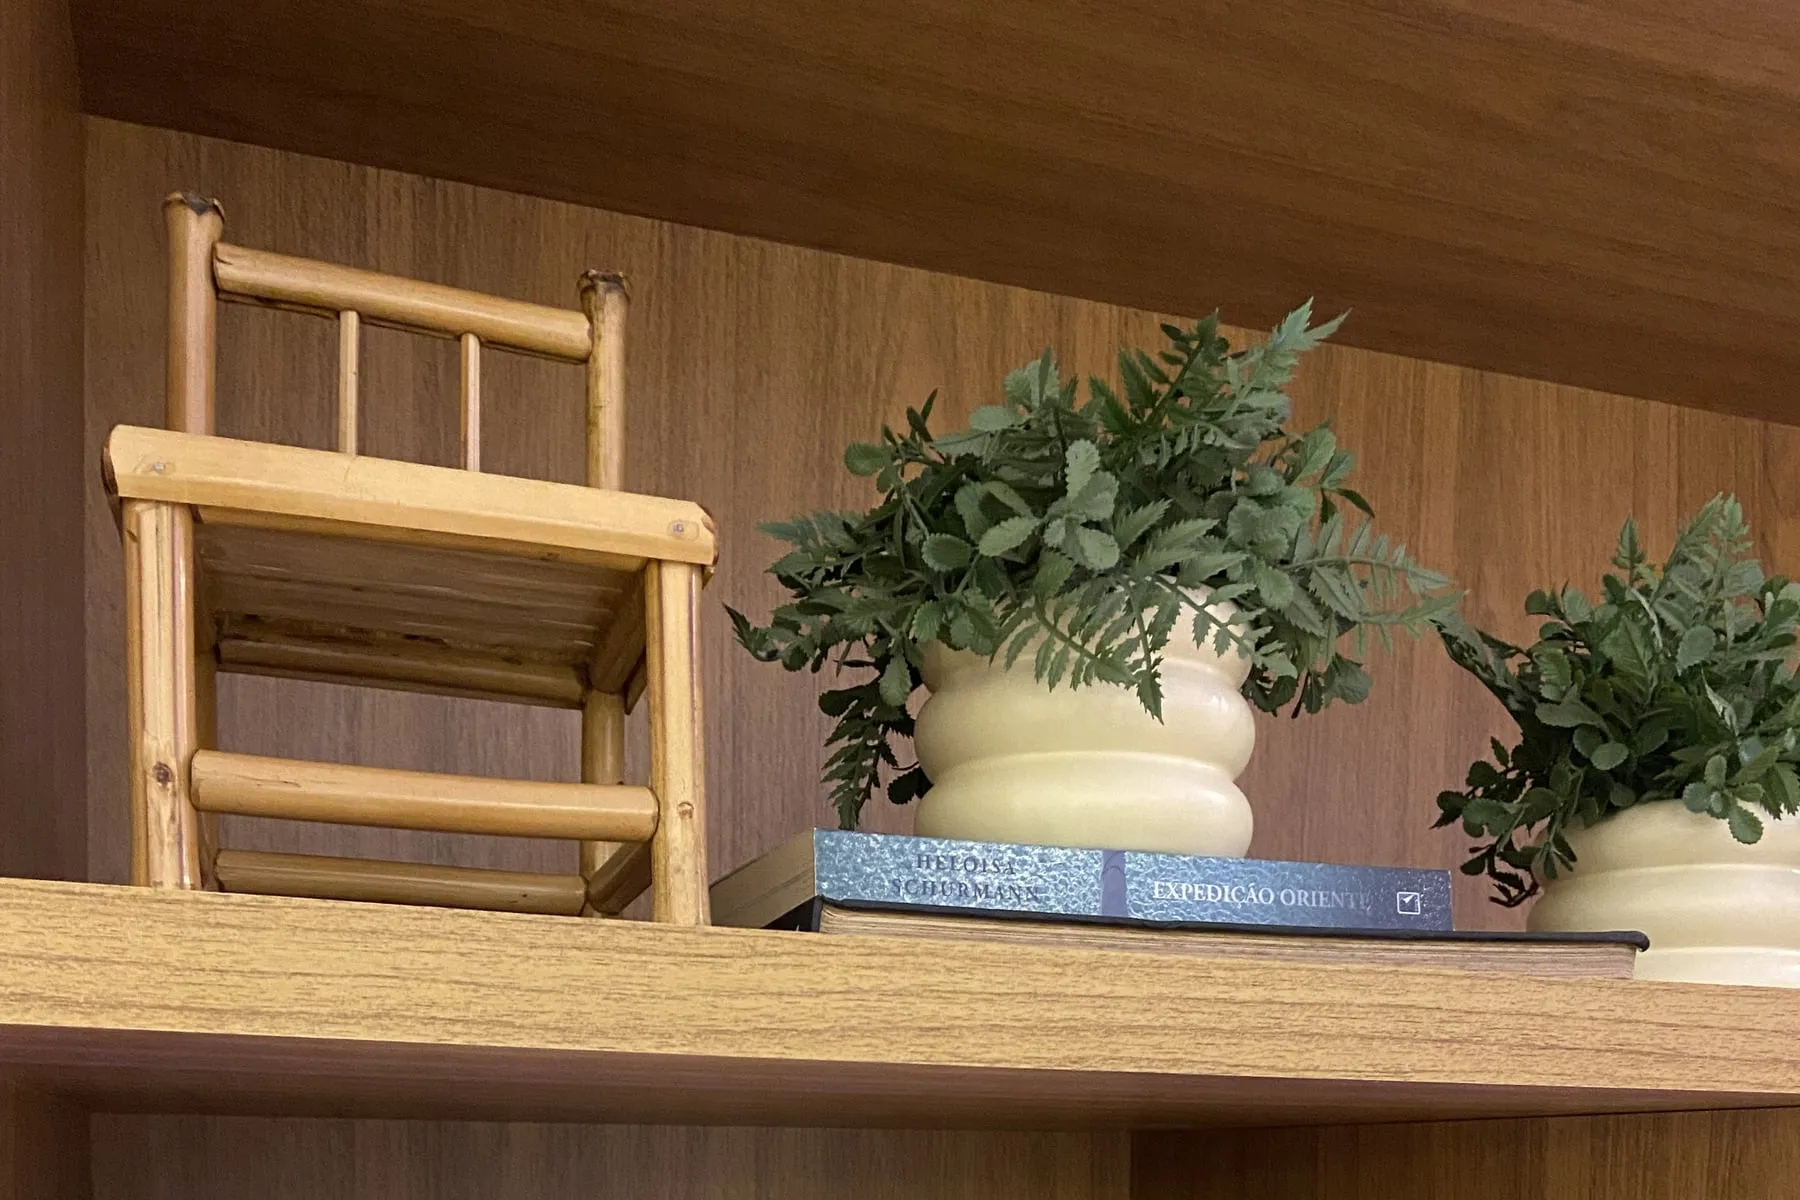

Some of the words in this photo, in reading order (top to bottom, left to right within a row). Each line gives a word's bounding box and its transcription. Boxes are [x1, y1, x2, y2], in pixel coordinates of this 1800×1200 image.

[917, 853, 1016, 876] HELOISA
[892, 879, 1040, 904] SCHURMANN
[1153, 880, 1275, 908] EXPEDIÇÃO
